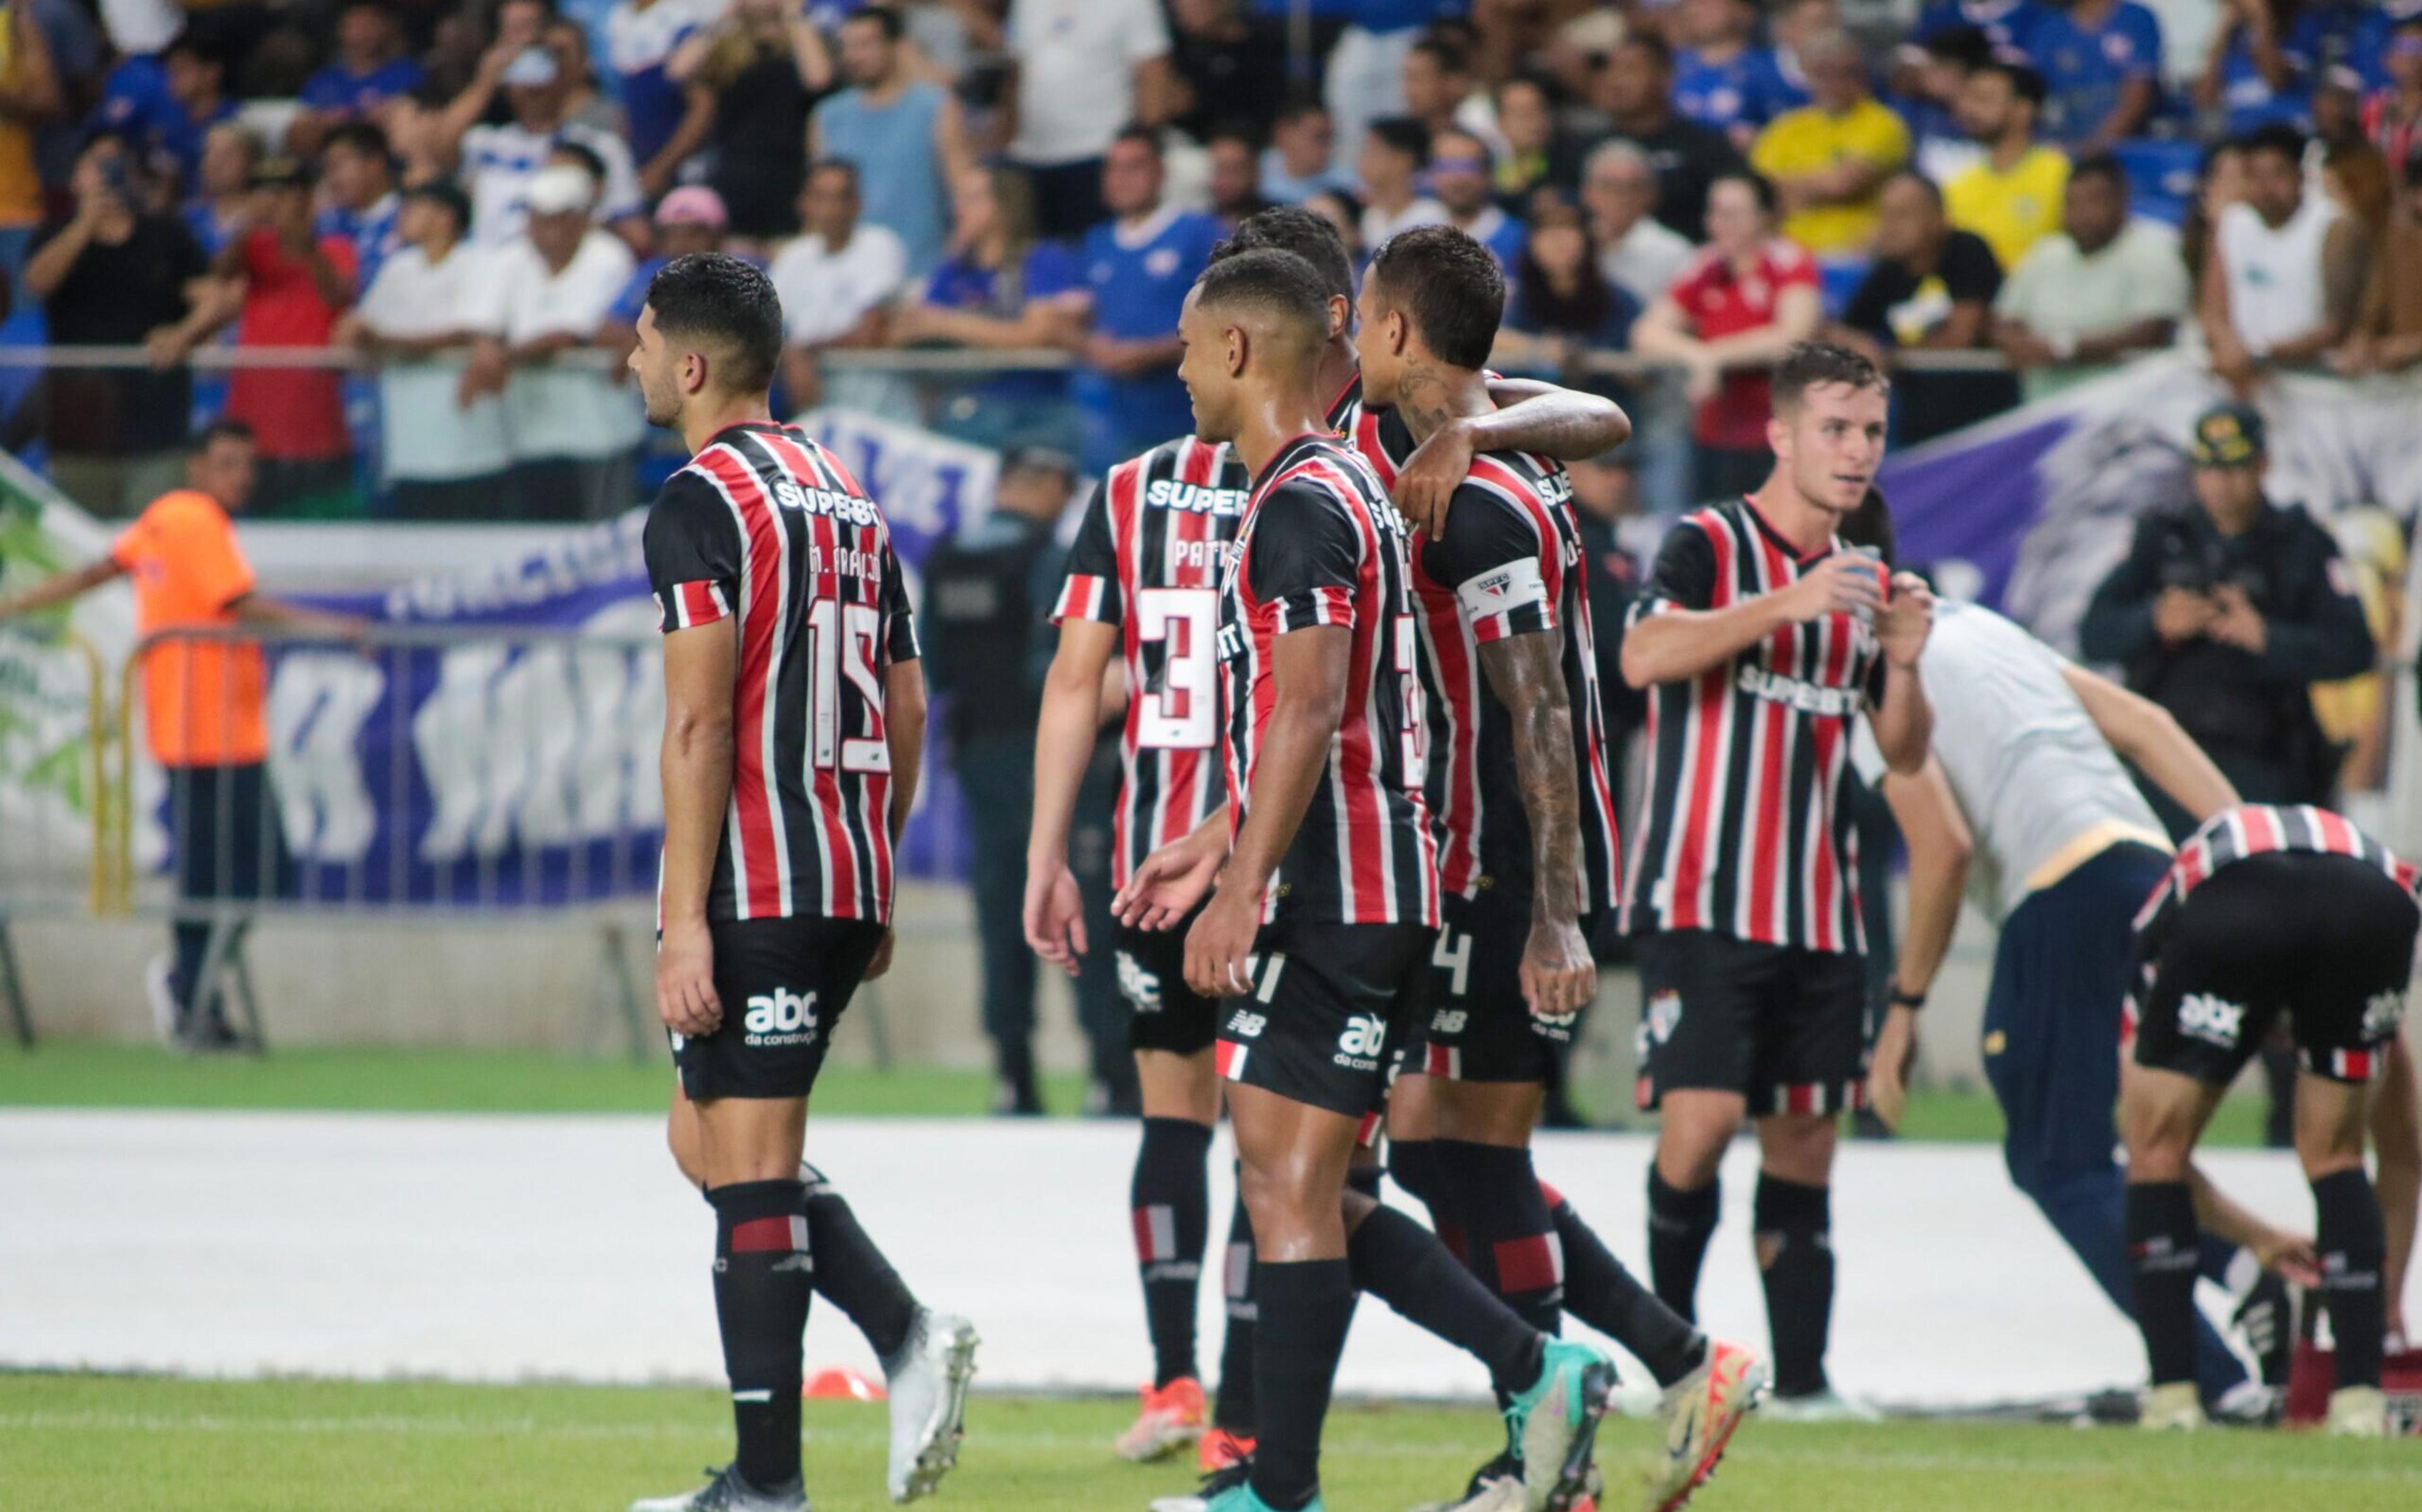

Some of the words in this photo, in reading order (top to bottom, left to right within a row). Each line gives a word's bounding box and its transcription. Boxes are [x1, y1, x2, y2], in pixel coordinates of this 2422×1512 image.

[807, 595, 891, 775] 15
[1137, 588, 1218, 748] 3
[1431, 921, 1472, 995] 4
[744, 986, 818, 1033] abc
[744, 1032, 762, 1046] da
[1338, 1011, 1387, 1057] ab
